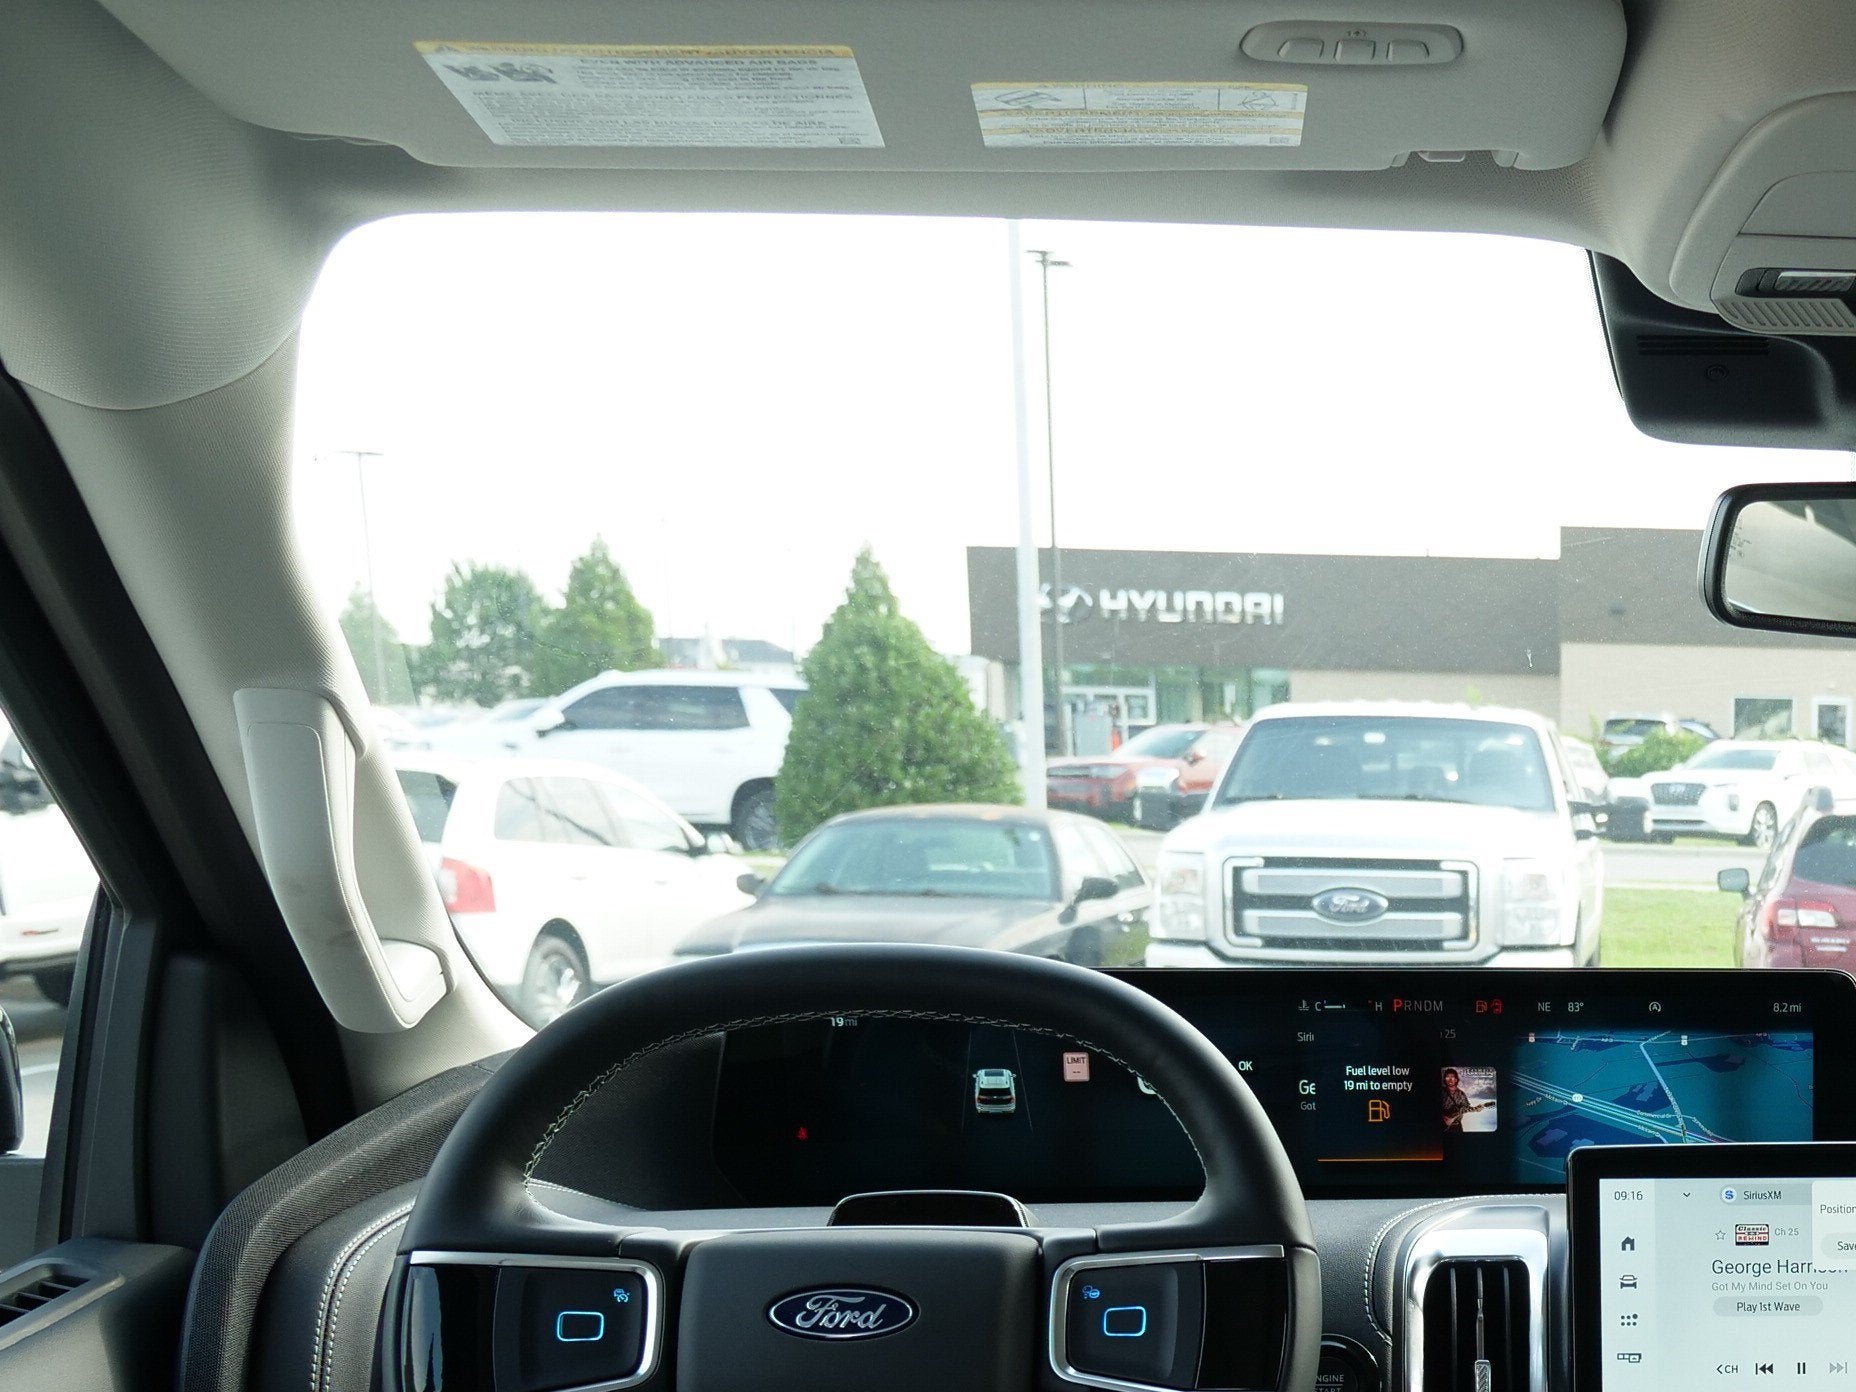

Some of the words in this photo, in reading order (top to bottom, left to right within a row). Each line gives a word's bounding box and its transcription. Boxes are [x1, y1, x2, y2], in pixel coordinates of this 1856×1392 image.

[1099, 588, 1284, 625] HYUNDAI
[1314, 1001, 1322, 1012] C
[1374, 1002, 1383, 1012] H
[1537, 1002, 1552, 1012] NE
[1567, 1002, 1585, 1013] 83°
[1773, 1002, 1788, 1013] 8.2
[1789, 1002, 1802, 1013] mi
[1066, 1057, 1087, 1066] LIMIT
[1238, 1062, 1253, 1071] OK
[1345, 1065, 1367, 1077] Fuel
[1368, 1065, 1392, 1077] level
[1393, 1065, 1410, 1077] low
[1344, 1080, 1355, 1091] 19
[1356, 1080, 1369, 1091] mi
[1370, 1081, 1381, 1091] to
[1382, 1081, 1413, 1095] empty
[1613, 1190, 1643, 1201] 09:16
[1743, 1190, 1782, 1201] SiriusXM
[1774, 1228, 1787, 1237] Ch
[1788, 1228, 1800, 1237] 25
[1711, 1259, 1772, 1278] George
[1777, 1260, 1848, 1274] Harr
[1711, 1281, 1728, 1291] Got
[1731, 1281, 1746, 1293] My
[1748, 1281, 1773, 1291] Mind
[1775, 1281, 1791, 1291] Set
[1793, 1281, 1808, 1291] On
[1810, 1281, 1829, 1291] You
[795, 1294, 887, 1329] Ford
[1736, 1301, 1758, 1314] Play
[1759, 1301, 1772, 1312] 1st
[1773, 1301, 1801, 1312] Wave
[1315, 1374, 1344, 1382] NGINE
